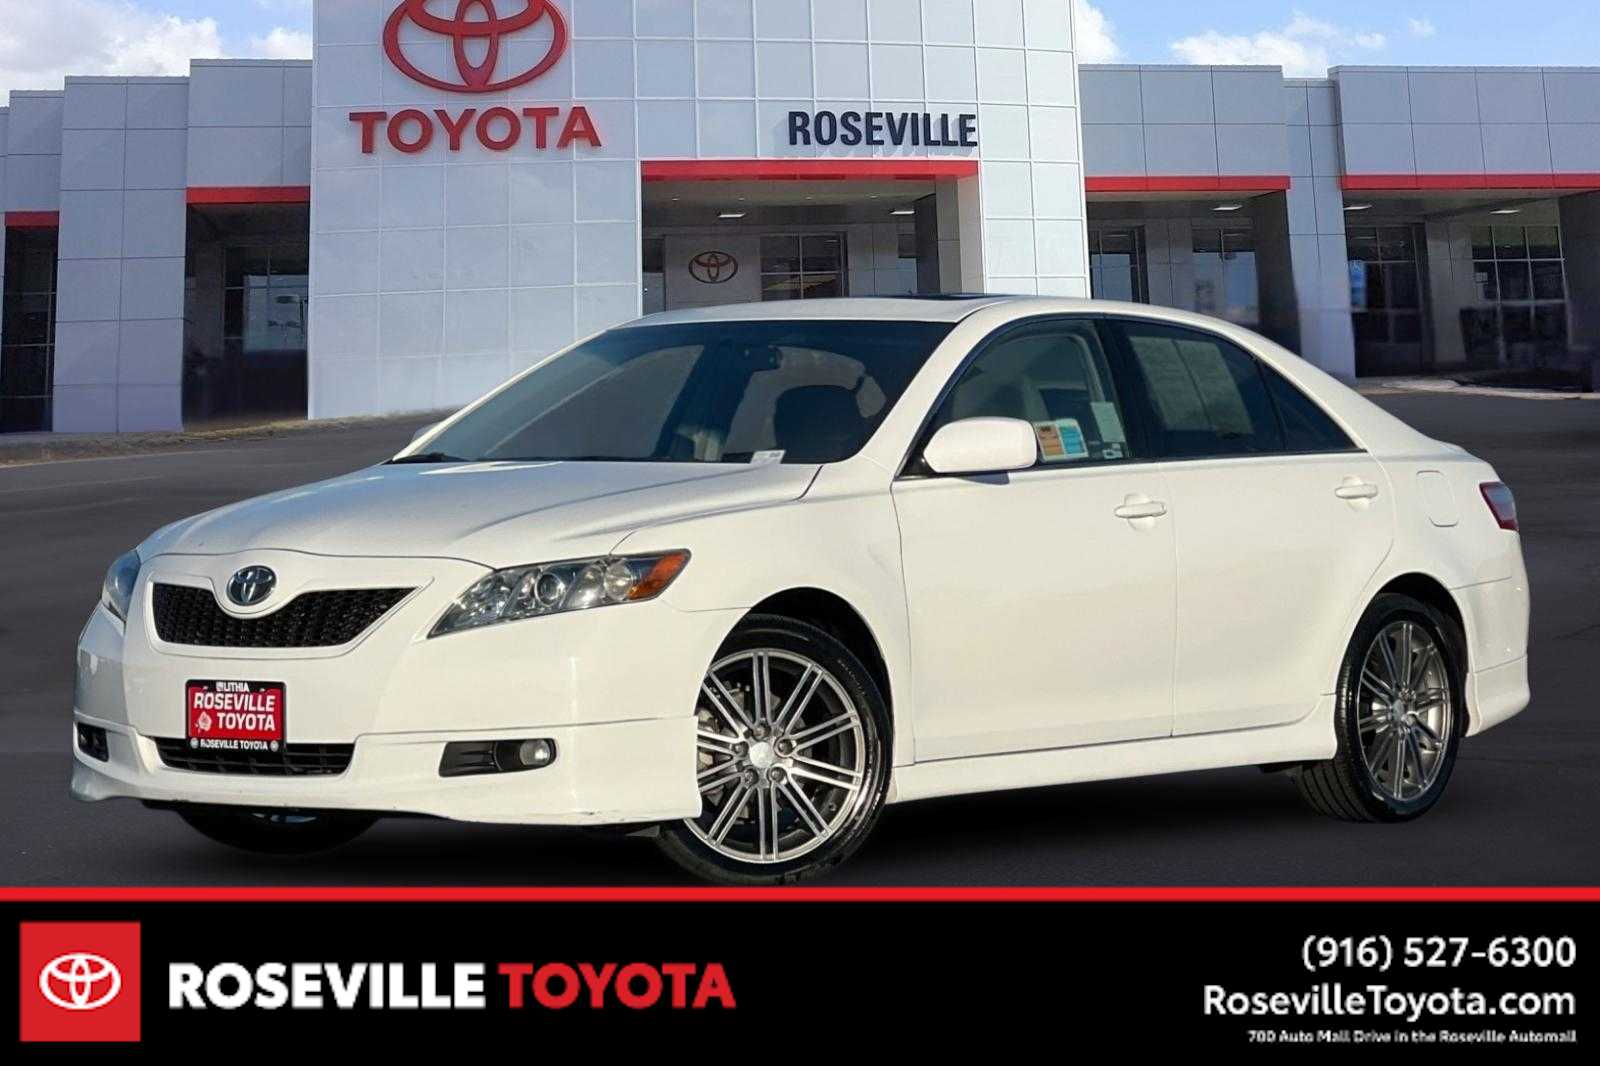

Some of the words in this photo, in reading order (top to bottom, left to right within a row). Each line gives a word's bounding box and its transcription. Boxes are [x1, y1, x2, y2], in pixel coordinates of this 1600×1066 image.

[349, 106, 602, 154] TOYOTA
[788, 111, 979, 148] ROSEVILLE
[193, 692, 276, 712] ROSEVILLE
[216, 712, 276, 731] TOYOTA
[200, 739, 239, 749] ROSEVILLE
[240, 740, 269, 750] TOYOTA
